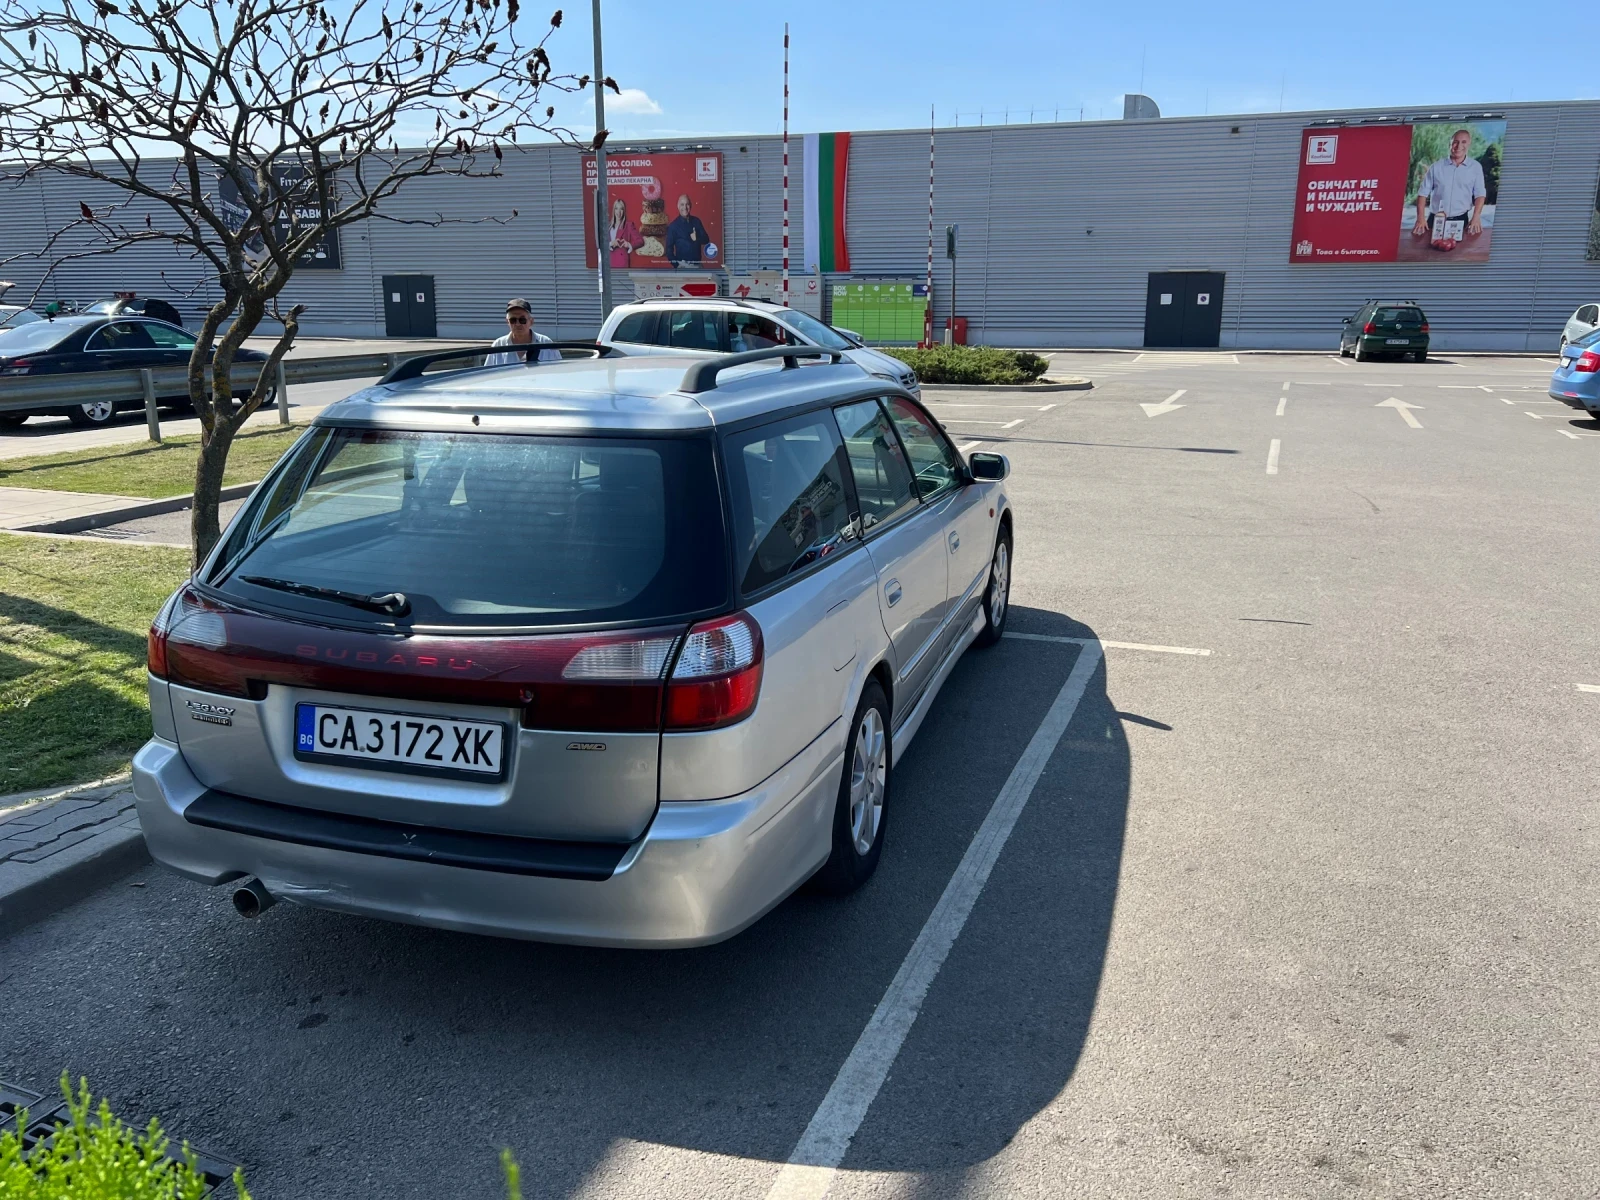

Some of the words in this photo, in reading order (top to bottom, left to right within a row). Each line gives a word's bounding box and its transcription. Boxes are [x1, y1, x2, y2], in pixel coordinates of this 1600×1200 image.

[586, 160, 620, 168] СЛКО.
[620, 159, 653, 167] СОЛЕНО.
[586, 168, 632, 176] ПРЕРЕНО.
[1308, 180, 1357, 190] ОБИЧАТ
[1359, 179, 1379, 189] МЕ
[1306, 192, 1316, 201] И
[1318, 191, 1375, 201] НАШИТЕ,
[1305, 203, 1314, 212] И
[1317, 202, 1382, 213] ЧУЖДИТЕ.
[1341, 248, 1380, 256] българско.
[296, 644, 473, 671] SUBARU
[185, 700, 236, 716] LEGACY
[300, 733, 313, 745] BG
[566, 742, 606, 751] AWD
